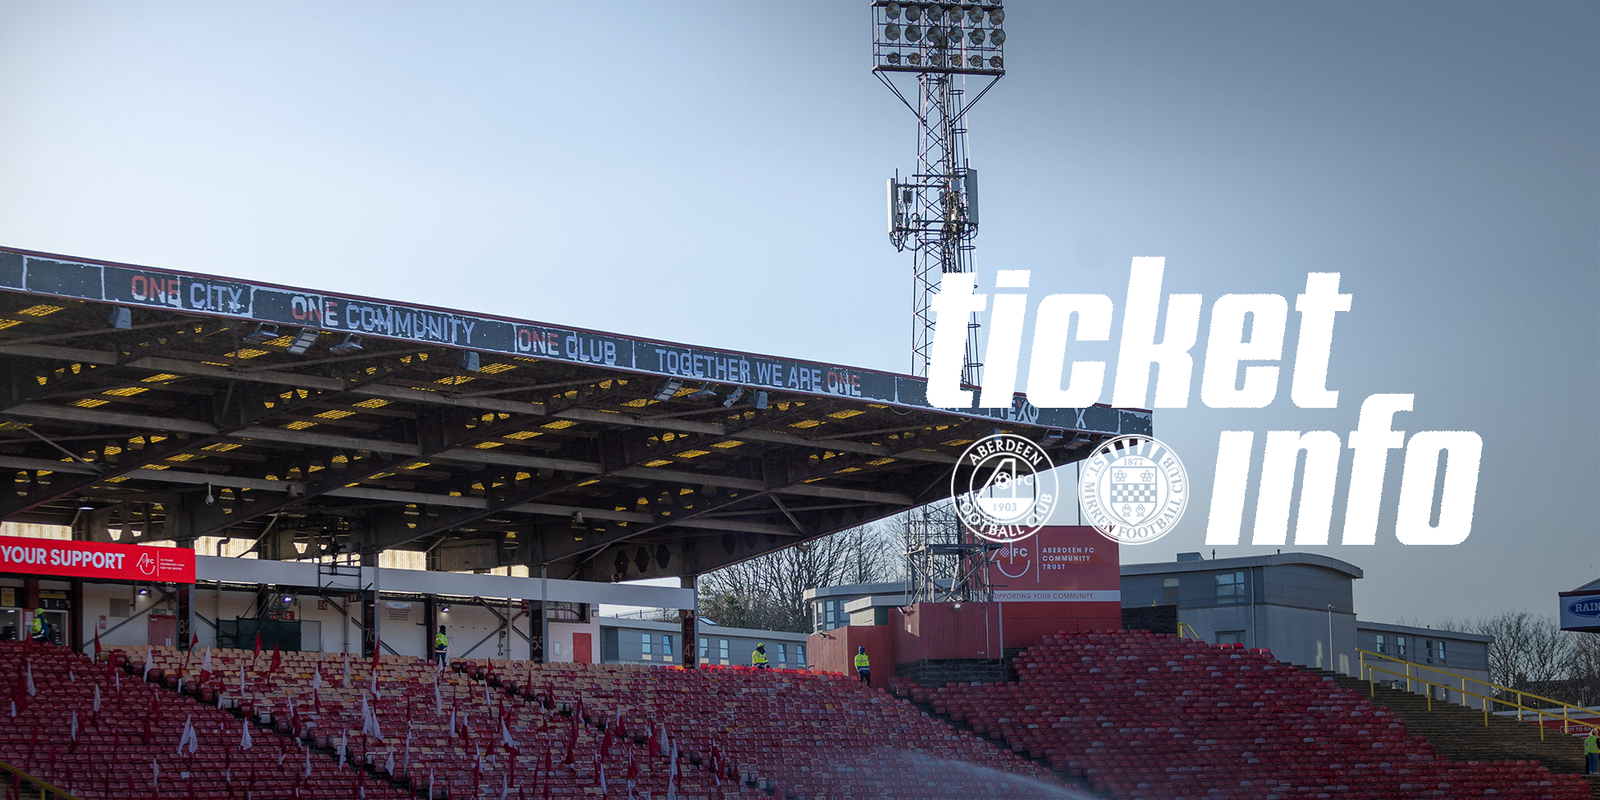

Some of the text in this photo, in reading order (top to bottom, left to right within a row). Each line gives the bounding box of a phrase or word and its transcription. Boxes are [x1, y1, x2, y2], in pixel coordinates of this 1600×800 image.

[131, 275, 861, 397] ONE CITY ONE COMMUNITY ONE CLUB TOGETHER WE ARE ONE
[1, 545, 125, 569] YOUR SUPPORT
[1013, 548, 1028, 557] FC
[1033, 592, 1052, 600] YOUR
[1053, 592, 1094, 600] COMMUNITY
